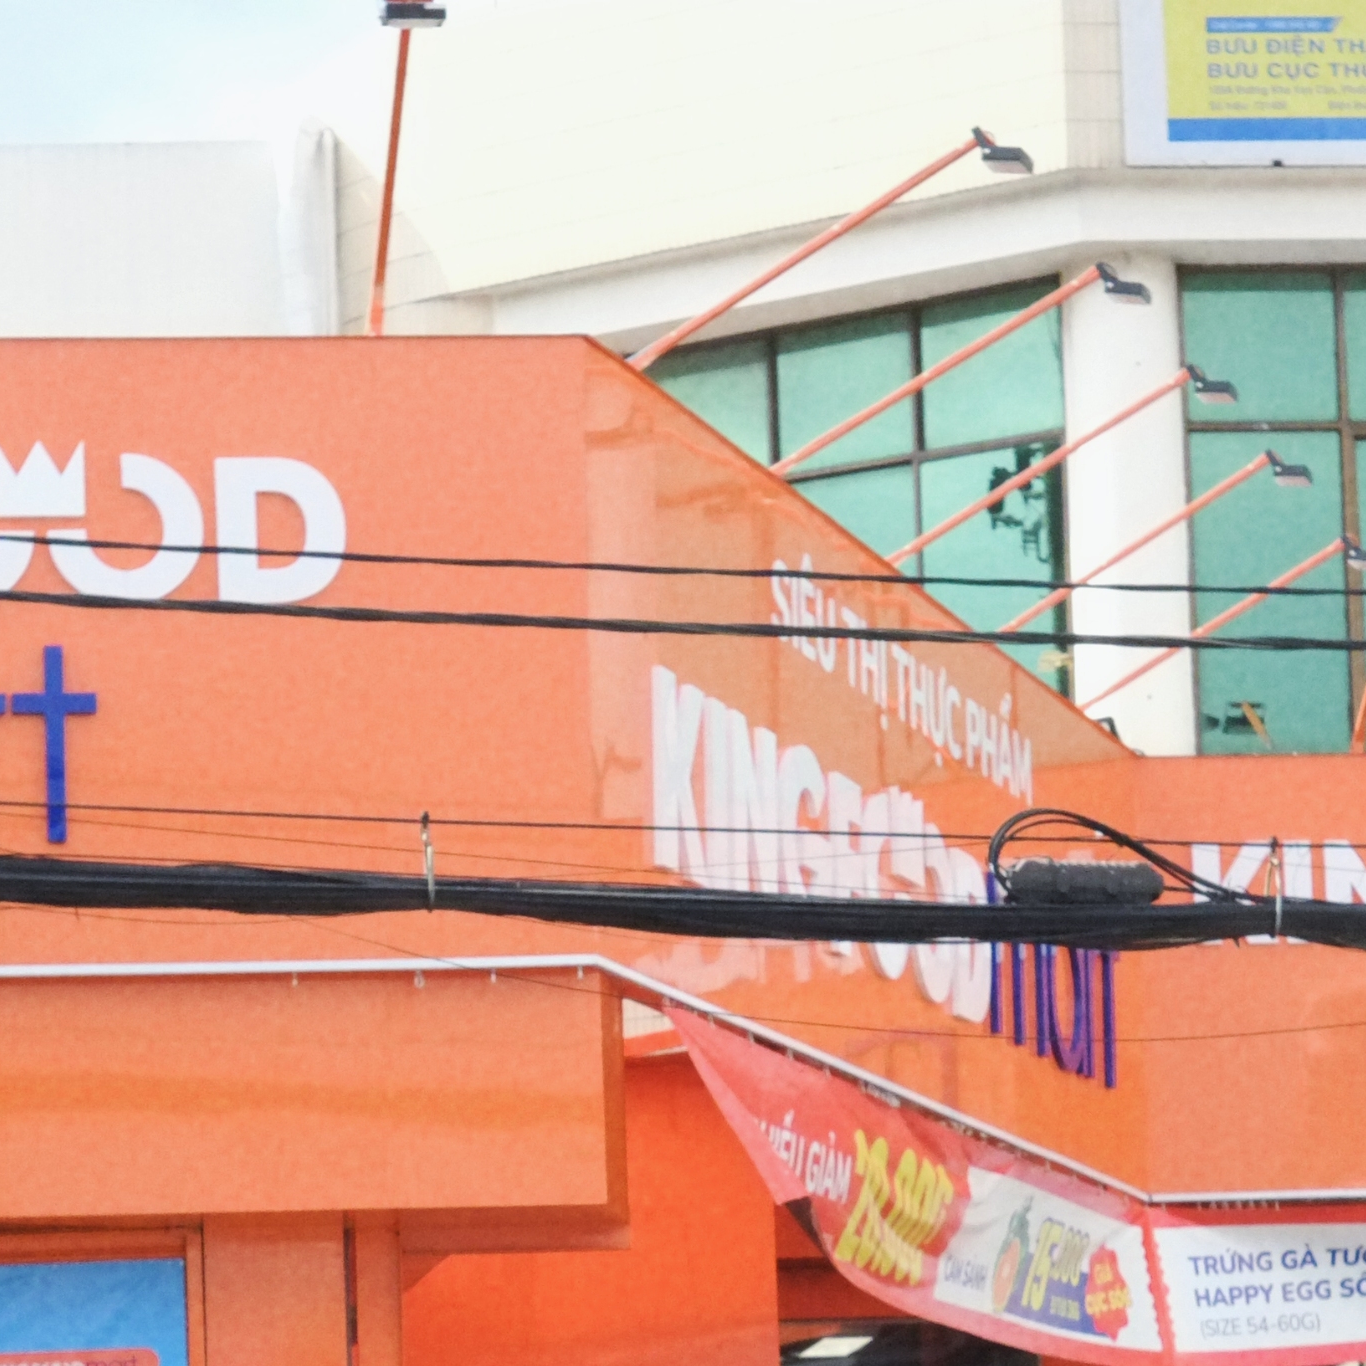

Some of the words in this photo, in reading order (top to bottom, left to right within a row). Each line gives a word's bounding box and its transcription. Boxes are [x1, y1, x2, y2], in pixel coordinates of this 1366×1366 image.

[769, 551, 838, 674] SIÊU
[840, 603, 890, 730] THỊ
[1280, 1241, 1317, 1270] GÀ
[1194, 1278, 1276, 1308] HAPPY
[1280, 1277, 1332, 1303] EGG
